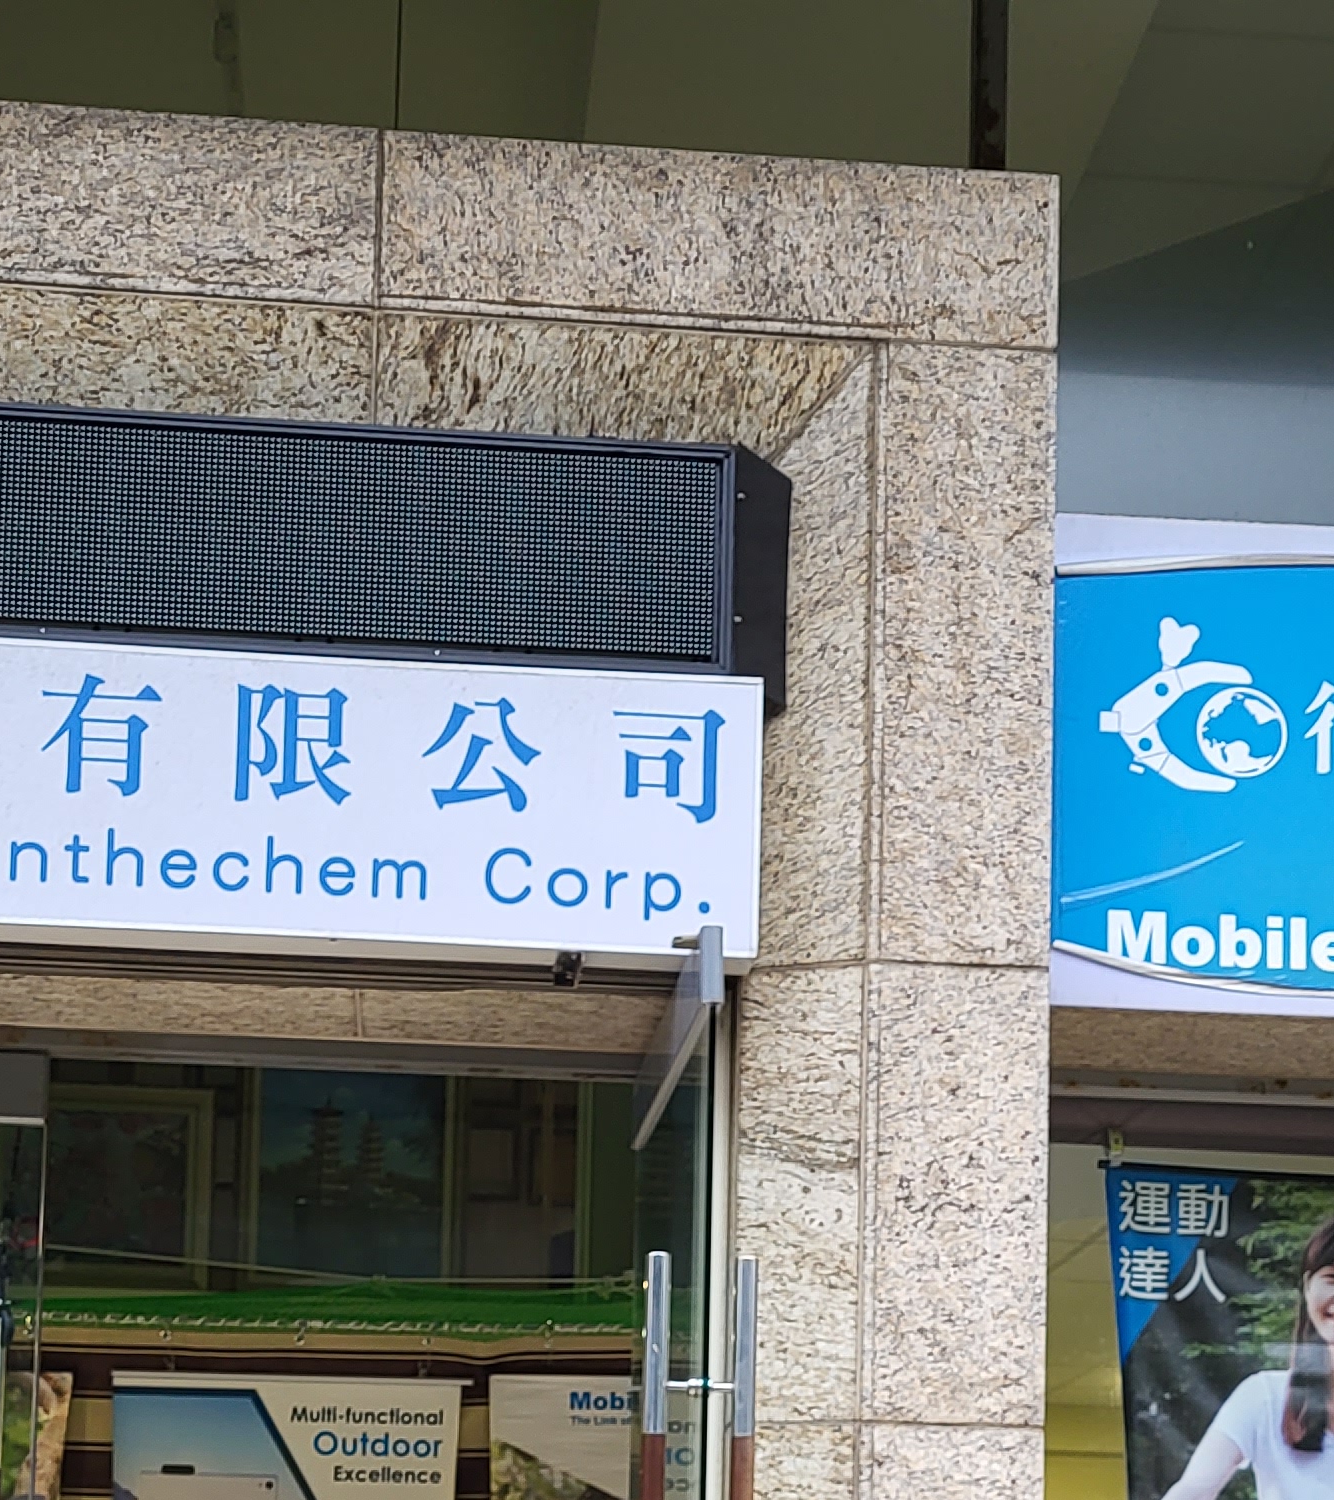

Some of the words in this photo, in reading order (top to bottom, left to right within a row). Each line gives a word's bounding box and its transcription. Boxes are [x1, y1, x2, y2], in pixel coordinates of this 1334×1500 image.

[484, 847, 711, 921] Corp.
[1118, 1178, 1229, 1237] 運動
[1119, 1248, 1227, 1304] 達人
[290, 1406, 444, 1426] Multi-functional
[313, 1431, 443, 1458] Outdoor
[332, 1465, 442, 1484] Excellence
